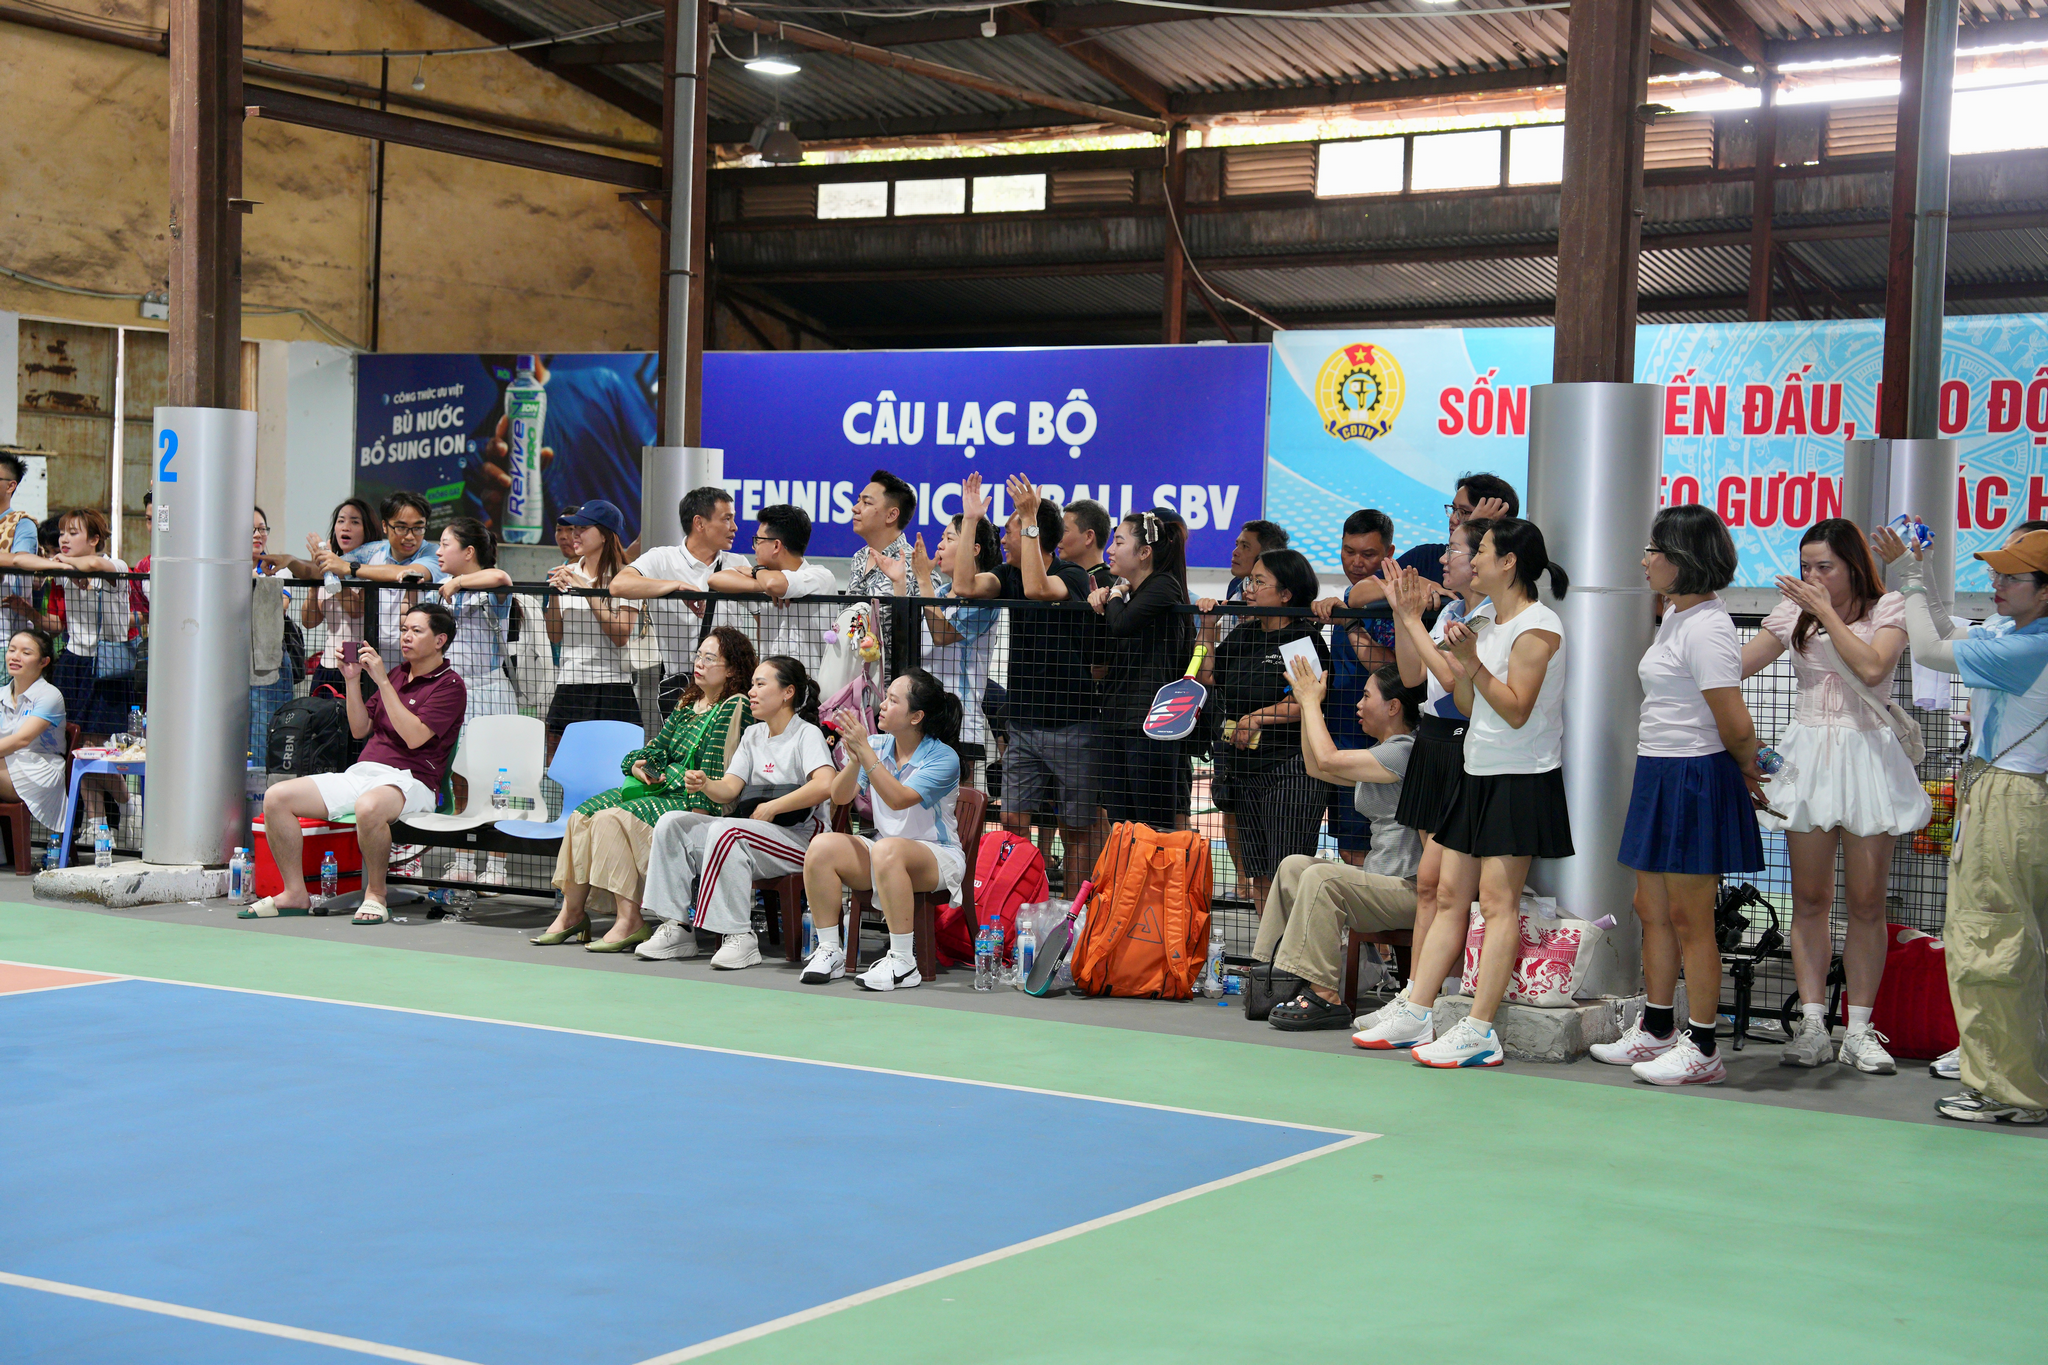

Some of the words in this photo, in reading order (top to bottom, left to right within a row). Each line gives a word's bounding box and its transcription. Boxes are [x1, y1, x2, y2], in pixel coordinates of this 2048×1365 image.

[393, 391, 416, 404] CÔNG
[417, 387, 436, 401] THỨC
[448, 383, 464, 398] VIỆT
[1438, 368, 1527, 436] SỐN
[1743, 365, 1855, 440] ĐẤU,
[392, 408, 413, 436] BÙ
[416, 403, 464, 433] NƯỚC
[842, 389, 925, 446] CÂU
[936, 400, 1017, 459] LẠC
[1027, 388, 1098, 459] BỘ
[158, 429, 178, 482] 2
[360, 435, 386, 467] BỔ
[388, 438, 431, 463] SUNG
[434, 433, 465, 457] ION
[722, 479, 854, 524] TENNIS
[1152, 484, 1240, 530] SBV
[1717, 471, 1844, 528] GƯƠN
[282, 735, 295, 770] CRBN
